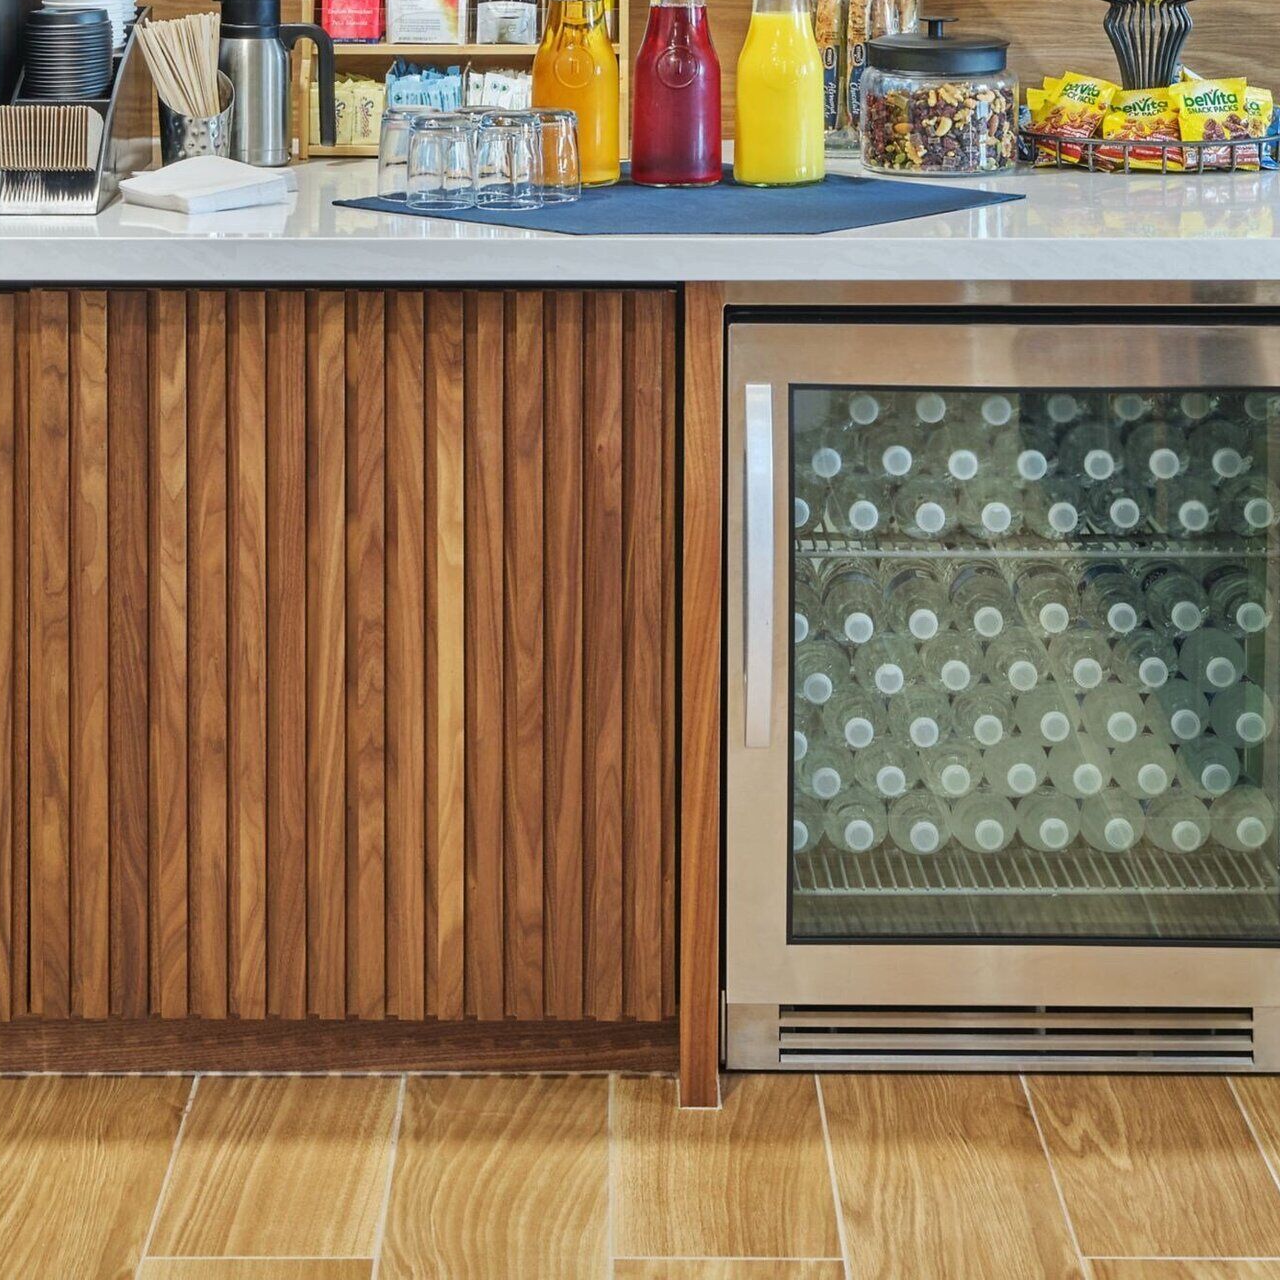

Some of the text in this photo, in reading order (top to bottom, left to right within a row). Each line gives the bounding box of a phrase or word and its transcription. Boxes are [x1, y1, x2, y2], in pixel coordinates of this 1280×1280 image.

[1183, 89, 1238, 108] belVita
[1186, 105, 1212, 115] SNACK
[1213, 104, 1239, 114] PACKS
